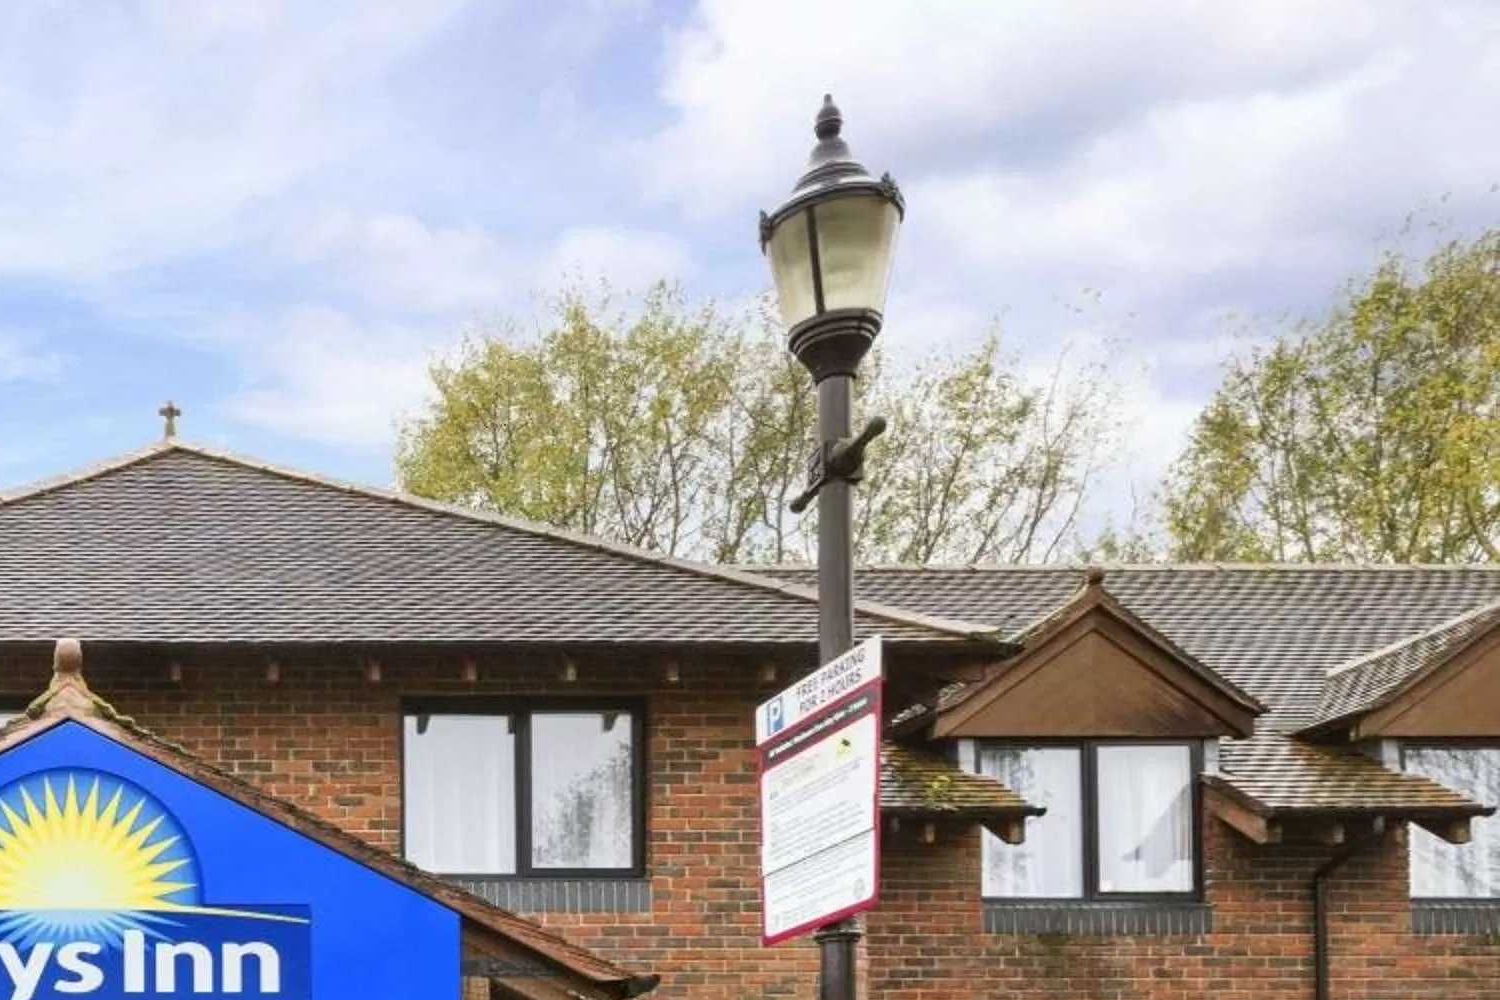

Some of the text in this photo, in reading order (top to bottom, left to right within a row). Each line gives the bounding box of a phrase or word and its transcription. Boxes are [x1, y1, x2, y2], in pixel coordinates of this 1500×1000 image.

[820, 647, 865, 684] PARKING
[827, 668, 862, 697] HOURS
[123, 928, 282, 993] Inn
